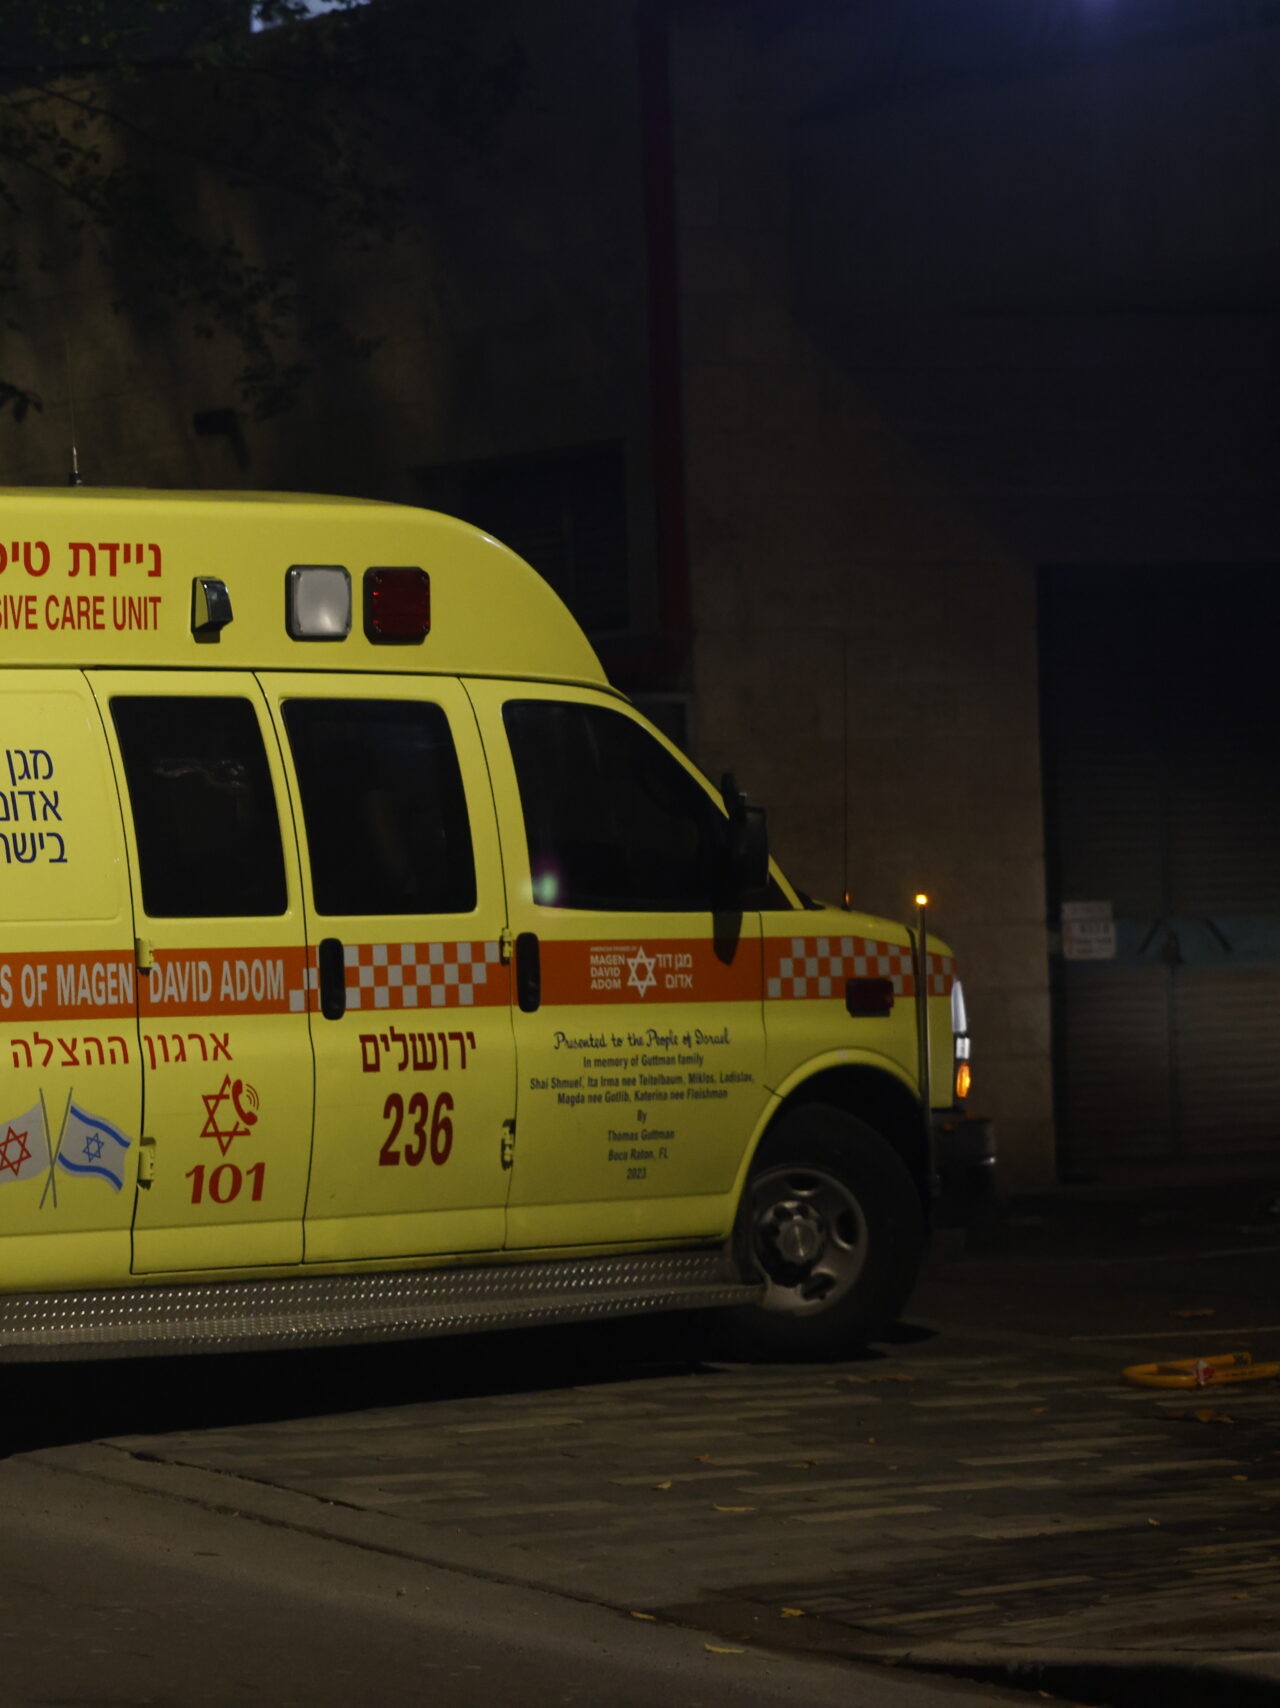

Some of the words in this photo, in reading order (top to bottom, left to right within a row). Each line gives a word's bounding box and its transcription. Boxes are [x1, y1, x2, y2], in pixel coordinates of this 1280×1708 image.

[68, 542, 162, 578] ניידת
[45, 595, 106, 631] CARE
[113, 596, 162, 631] UNIT
[10, 749, 55, 787] מגן
[589, 954, 626, 966] MAGEN
[655, 953, 673, 968] דוד
[674, 953, 693, 971] מגן
[590, 966, 621, 978] DAVID
[664, 974, 693, 989] אדום
[20, 963, 48, 1008] OF
[56, 962, 135, 1006] MAGEN
[148, 960, 213, 1004] DAVID
[220, 959, 285, 1002] ADOM
[590, 978, 622, 990] ADOM
[553, 1031, 608, 1050] Presented
[611, 1033, 624, 1047] to
[627, 1031, 644, 1047] the
[646, 1028, 678, 1051] People
[682, 1031, 692, 1049] of
[694, 1027, 731, 1046] Israel
[11, 1031, 129, 1069] ההצלה
[143, 1032, 234, 1071] ארגון
[359, 1026, 476, 1073] ירושלים
[583, 1056, 592, 1068] In
[594, 1056, 628, 1070] memory
[630, 1055, 639, 1067] of
[641, 1054, 676, 1067] Guttman
[677, 1052, 704, 1068] family
[530, 1077, 549, 1090] Shai
[600, 1075, 620, 1088] Irma
[621, 1077, 637, 1087] nee
[557, 1092, 585, 1107] Magda
[587, 1093, 603, 1104] nee
[634, 1088, 668, 1101] Katerina
[670, 1088, 685, 1100] nee
[686, 1087, 728, 1099] Fleishman
[637, 1109, 647, 1123] By
[378, 1091, 455, 1167] 236
[608, 1129, 639, 1142] Thomas
[641, 1128, 675, 1141] Guttman
[608, 1149, 628, 1161] Boca
[659, 1147, 668, 1159] FL
[185, 1162, 266, 1205] 101
